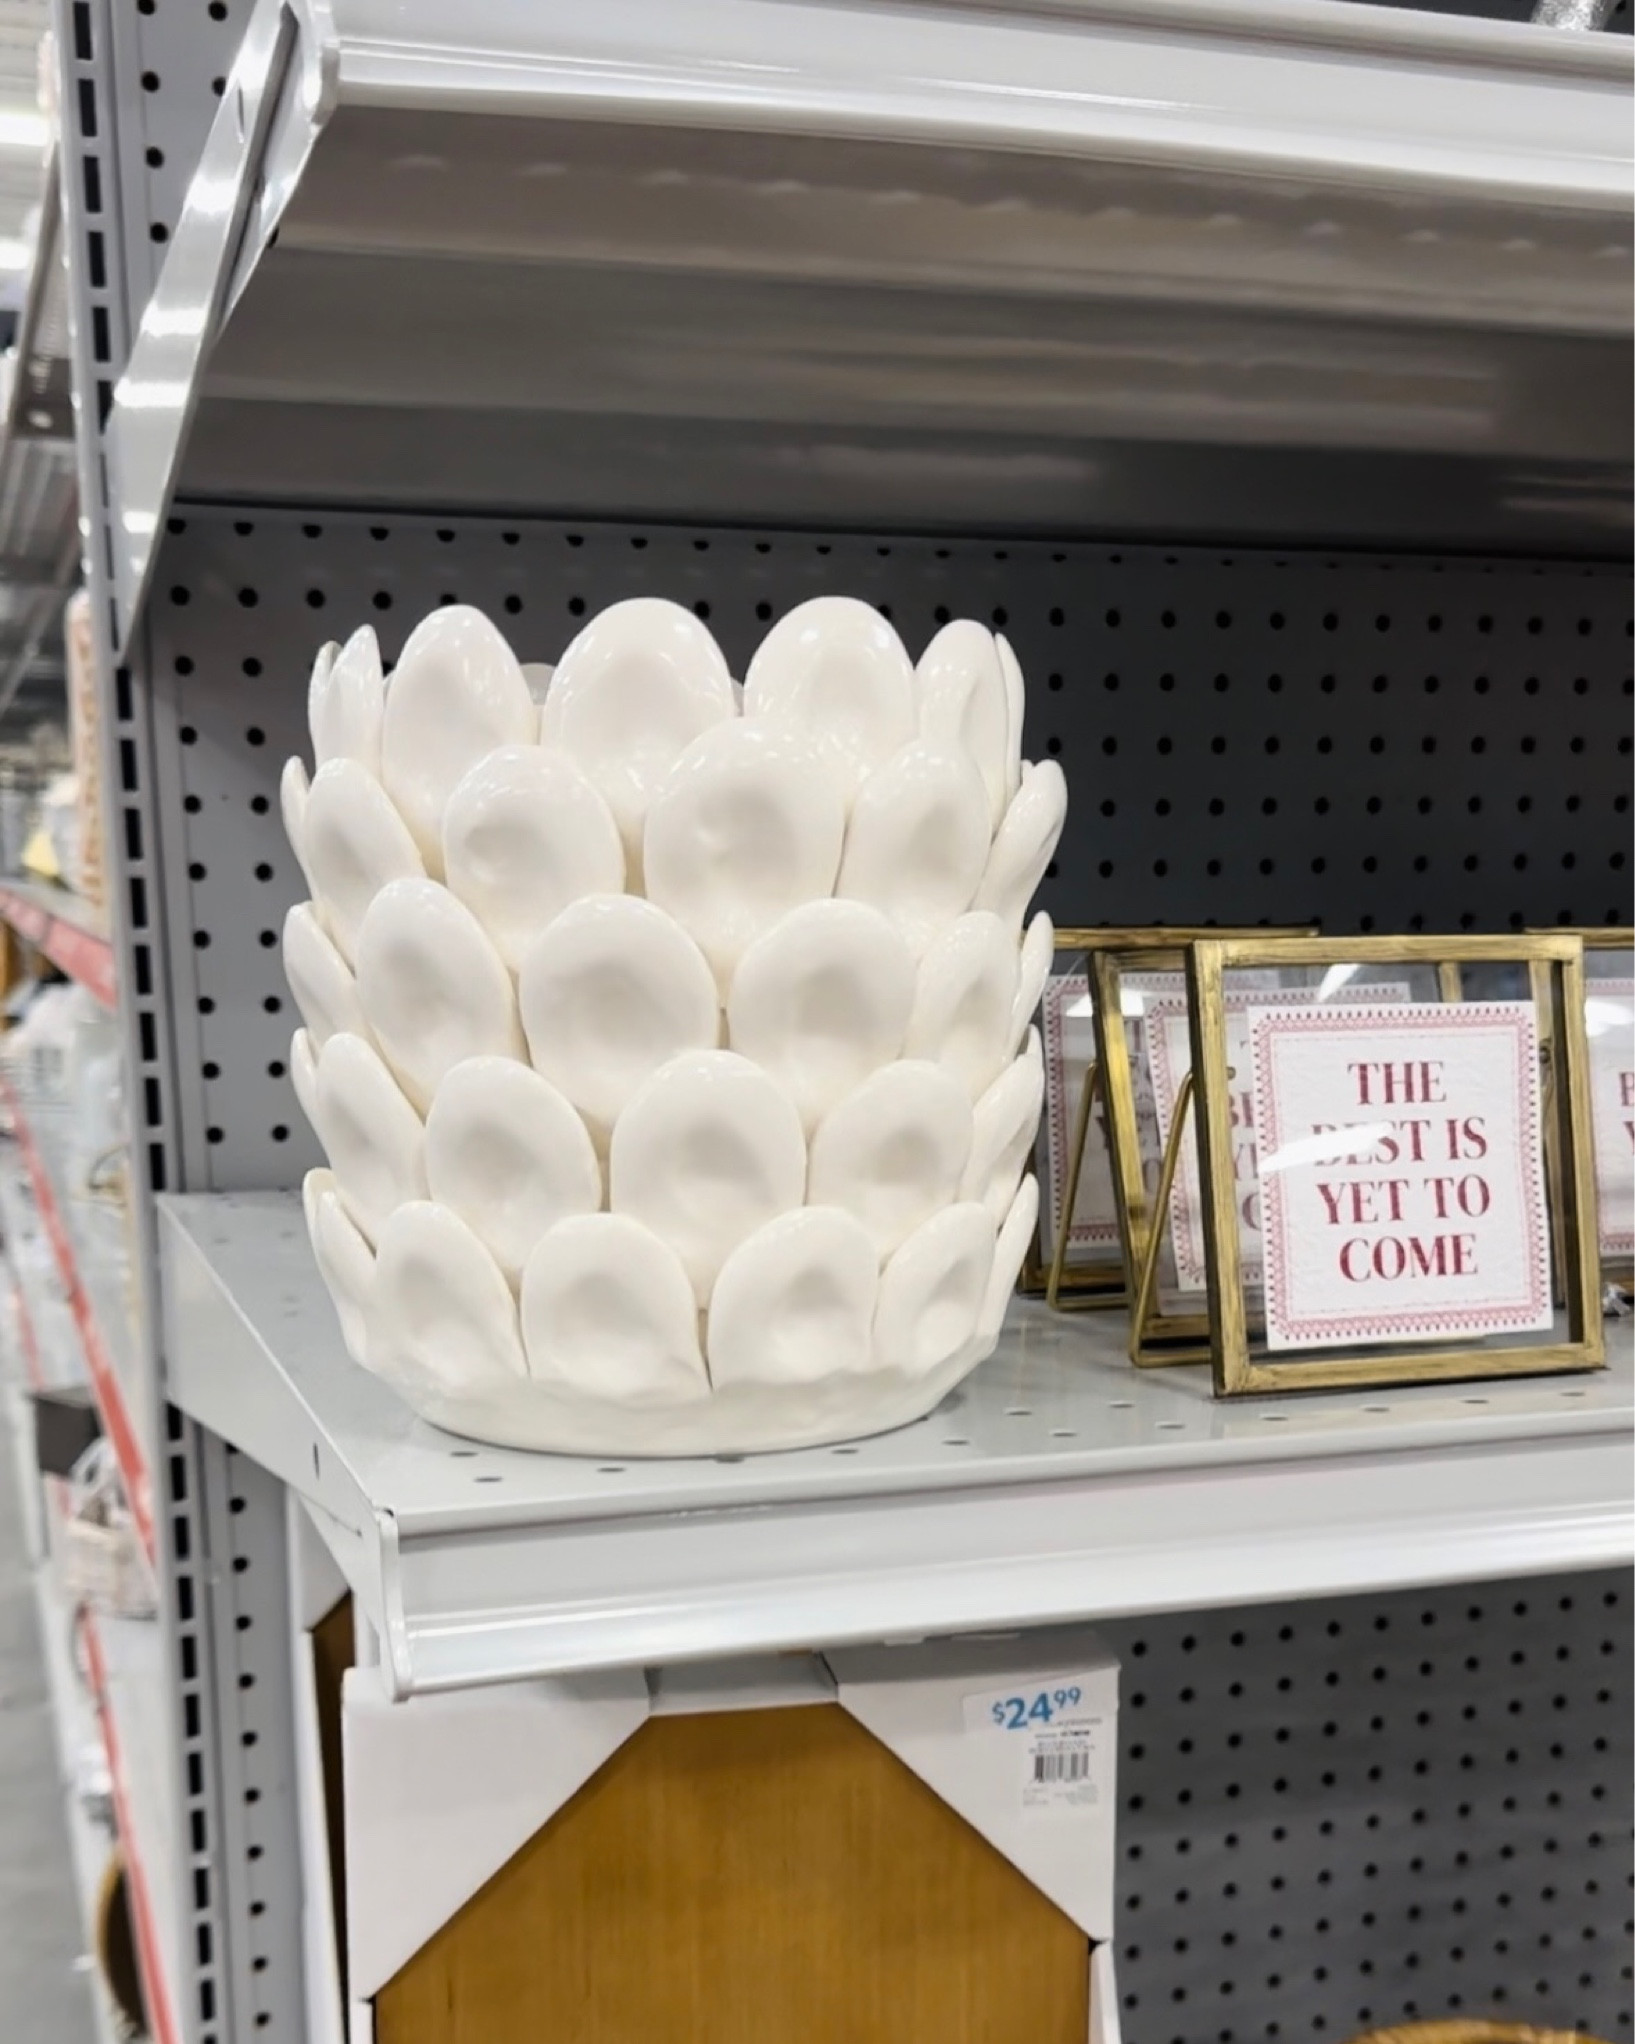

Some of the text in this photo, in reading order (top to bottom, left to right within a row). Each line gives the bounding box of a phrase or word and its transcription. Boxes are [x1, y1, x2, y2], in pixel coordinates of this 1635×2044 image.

[1347, 1060, 1447, 1106] THE
[1445, 1116, 1488, 1161] IS
[1316, 1178, 1411, 1225] YET
[1423, 1173, 1491, 1219] TO
[1338, 1233, 1479, 1284] COME
